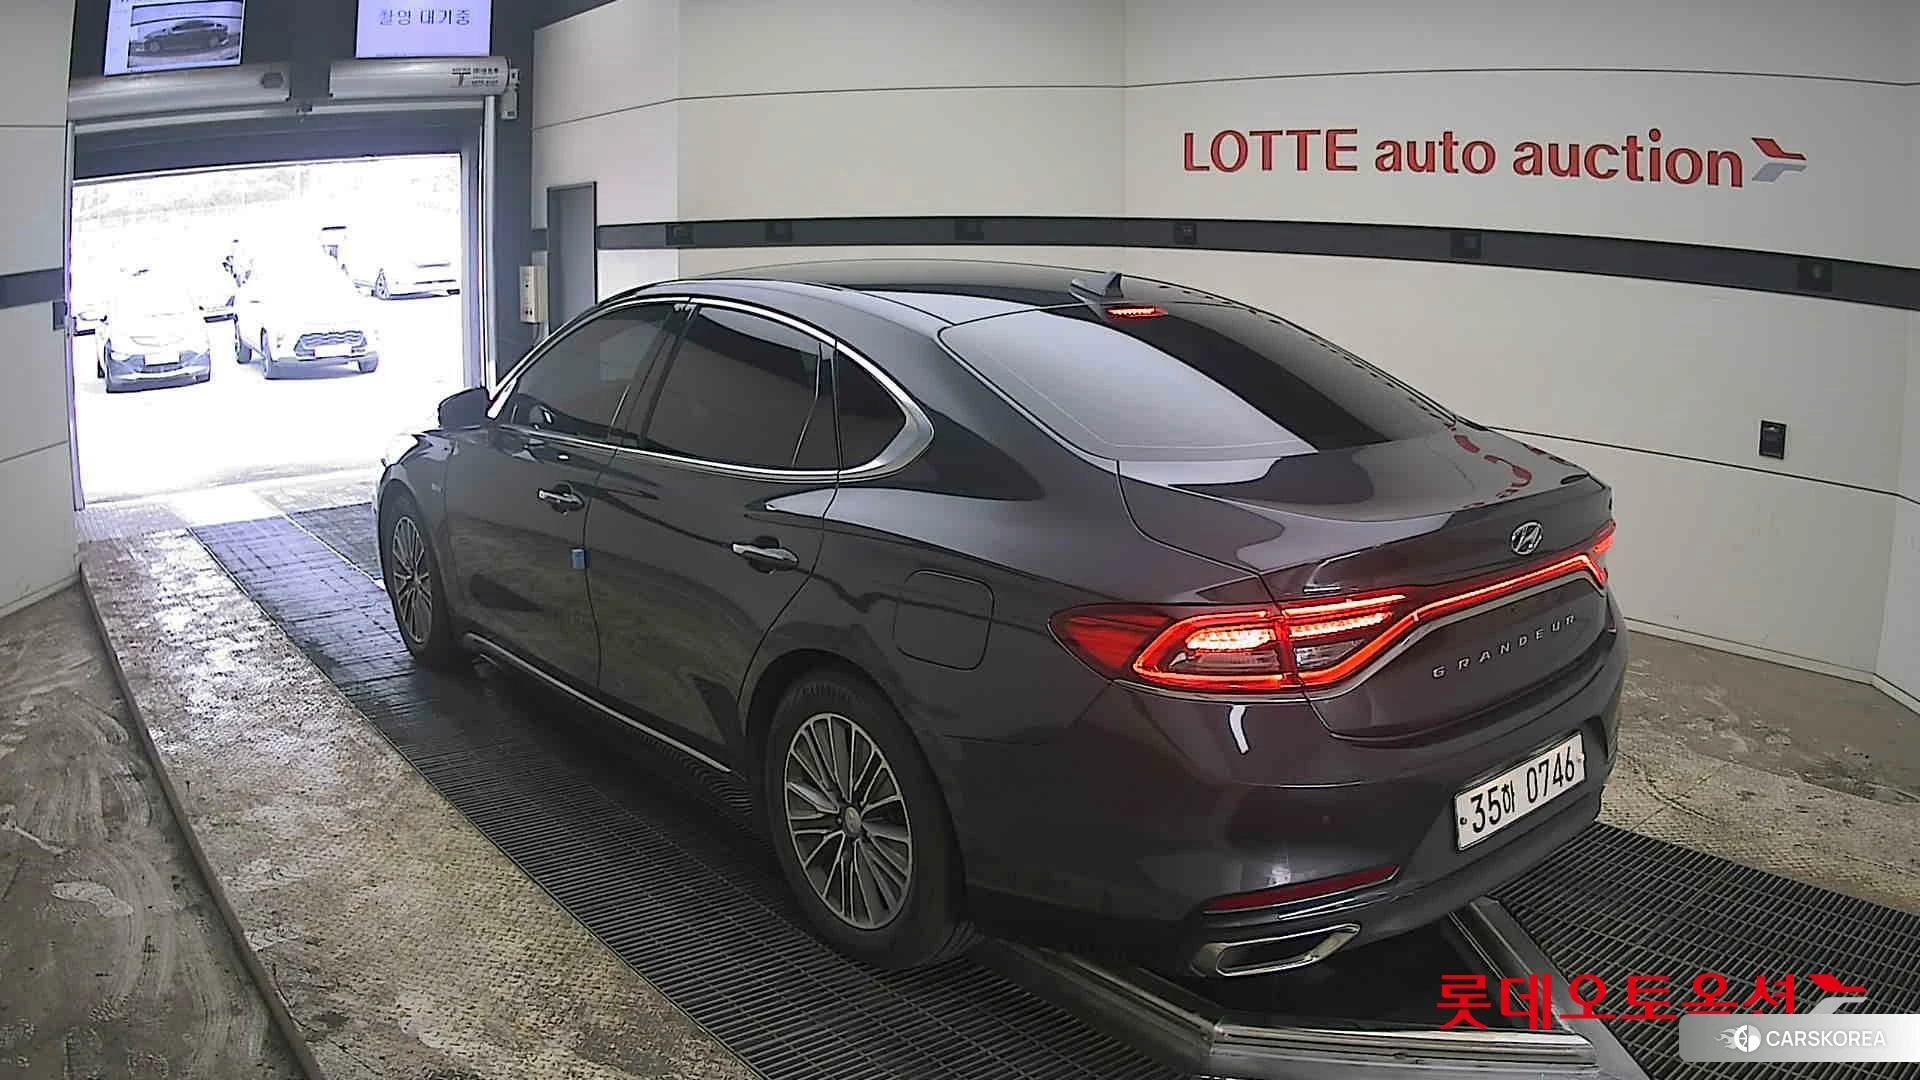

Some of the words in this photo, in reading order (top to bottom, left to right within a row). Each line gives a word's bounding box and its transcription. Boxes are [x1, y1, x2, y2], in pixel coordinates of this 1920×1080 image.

[420, 8, 471, 26] 대기중
[1183, 129, 1358, 172] LOTTE
[1375, 130, 1496, 176] auto
[1513, 128, 1743, 187] auction
[1432, 614, 1575, 679] GRANDEUR
[1470, 779, 1515, 833] 35하
[1526, 746, 1575, 804] 0746
